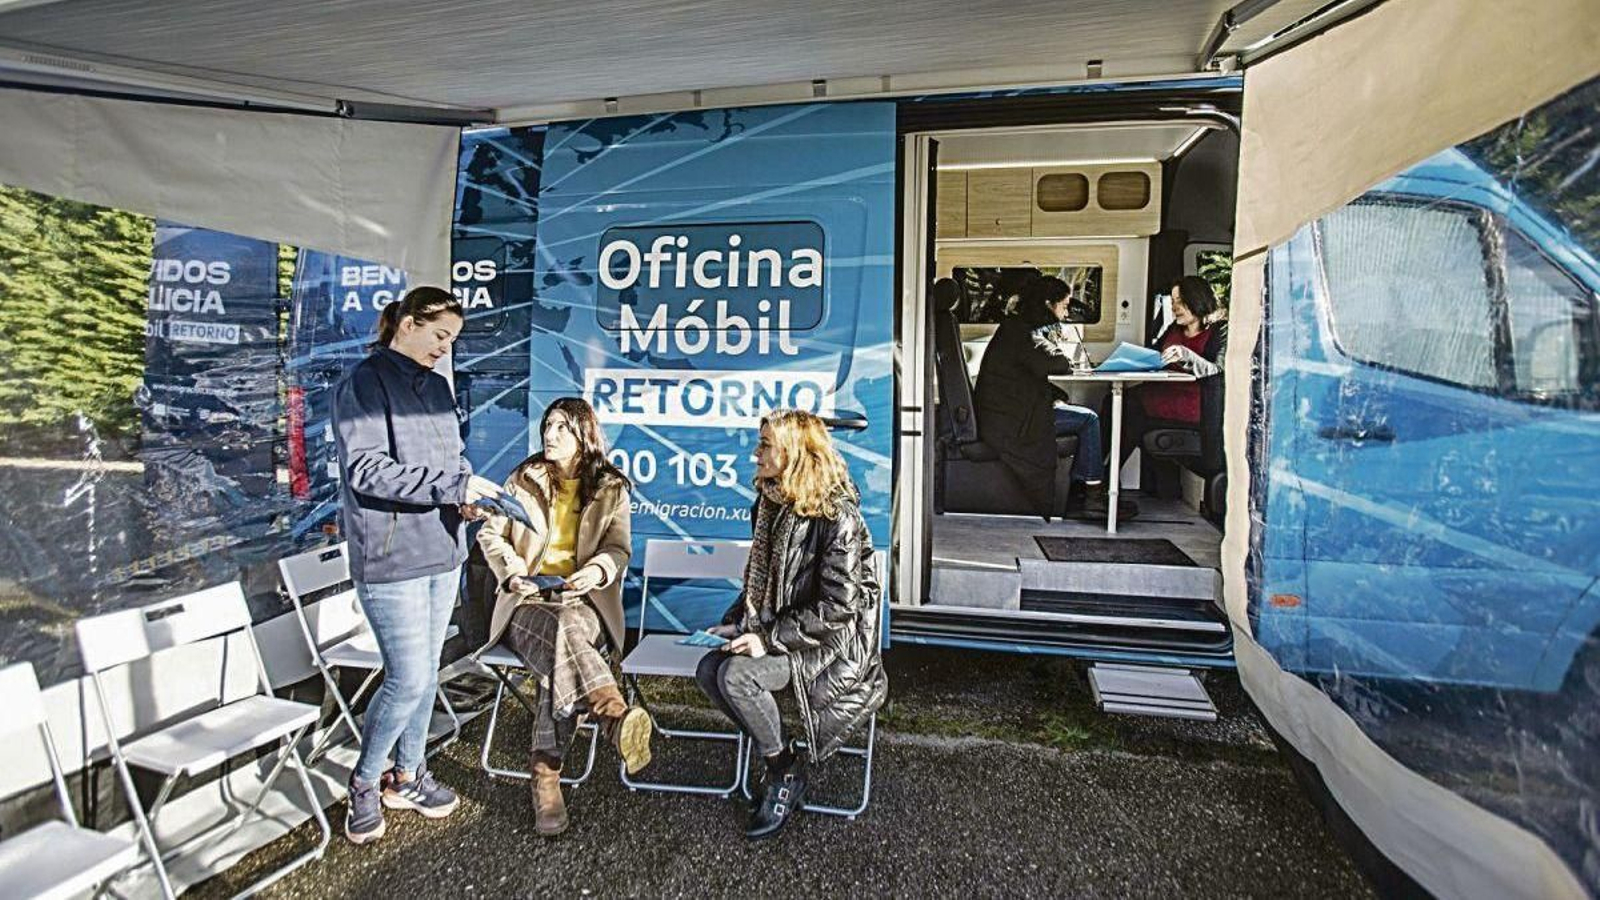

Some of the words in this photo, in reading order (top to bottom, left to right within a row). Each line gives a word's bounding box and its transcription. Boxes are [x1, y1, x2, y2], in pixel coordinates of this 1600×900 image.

[599, 234, 822, 289] Oficina
[342, 291, 363, 311] A
[172, 324, 236, 340] RETORNO
[620, 299, 799, 355] Móbil
[592, 377, 823, 417] RETORNO
[668, 452, 738, 488] 103
